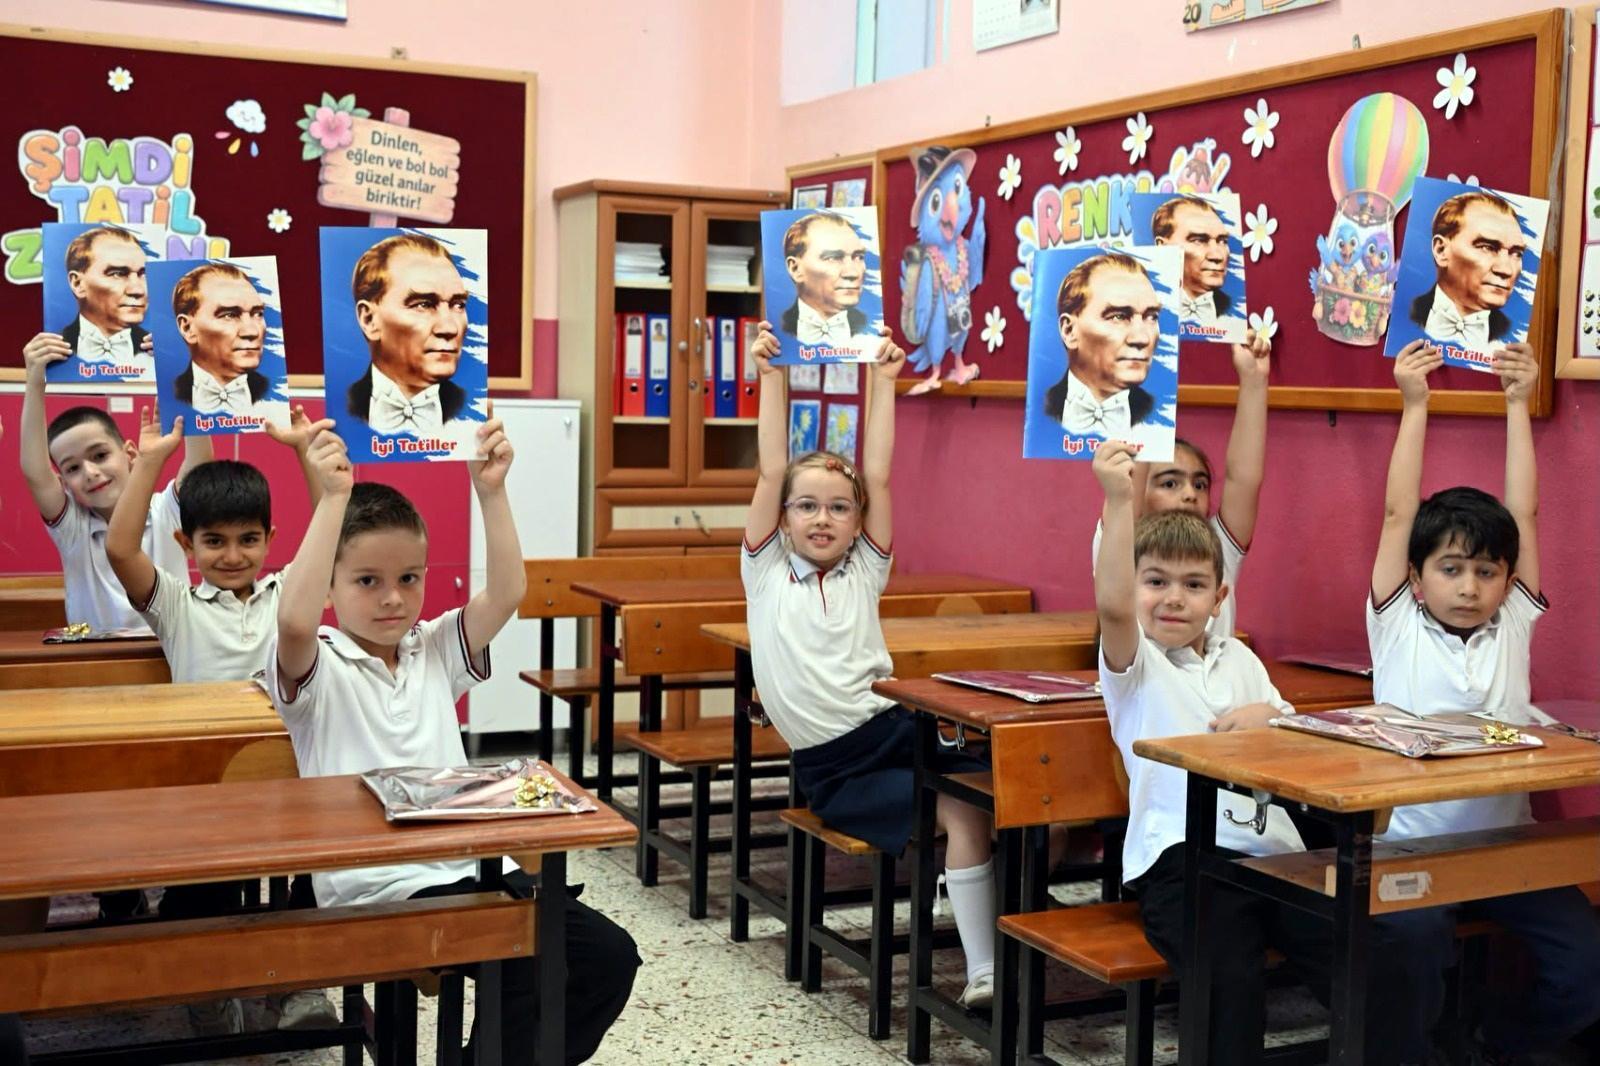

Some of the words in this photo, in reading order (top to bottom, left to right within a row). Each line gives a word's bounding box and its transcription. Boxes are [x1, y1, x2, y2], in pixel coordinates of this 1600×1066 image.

[371, 130, 423, 155] Dinlen,
[24, 128, 192, 193] ŞİMDİ
[346, 148, 385, 166] eğlen
[388, 157, 403, 169] ve
[406, 157, 426, 174] bol
[429, 162, 449, 178] bol
[355, 169, 394, 187] güzel
[397, 176, 436, 194] anılar
[48, 185, 201, 235] TATİL
[366, 188, 422, 210] biriktir!
[1187, 325, 1228, 336] Tatiller
[99, 364, 146, 375] Tatiller
[216, 416, 266, 427] Tatiller
[372, 436, 394, 456] İyi
[398, 438, 458, 452] Tatiller
[1064, 435, 1082, 454] İyi
